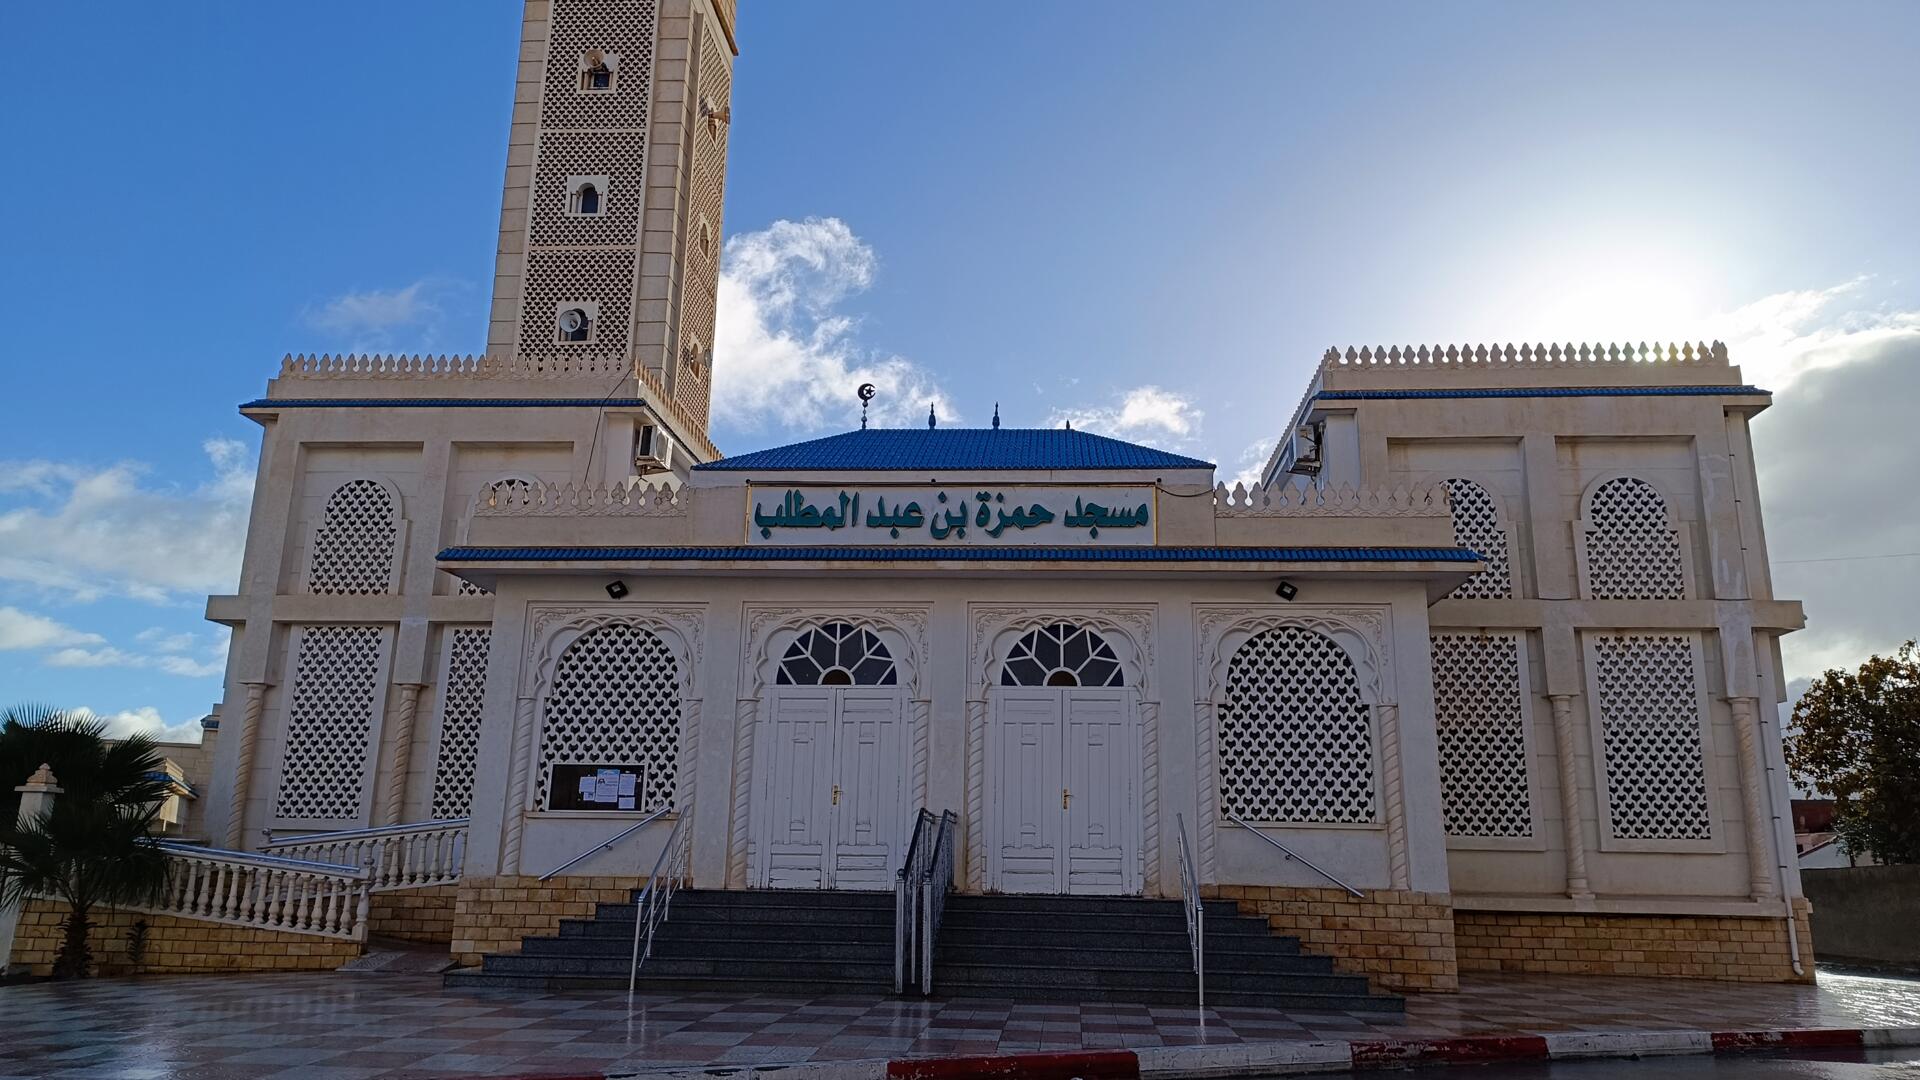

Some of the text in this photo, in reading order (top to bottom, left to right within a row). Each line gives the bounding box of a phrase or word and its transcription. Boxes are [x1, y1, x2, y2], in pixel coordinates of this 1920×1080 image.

[754, 489, 1149, 540] مسجد حمزة بن عبد المطلب
